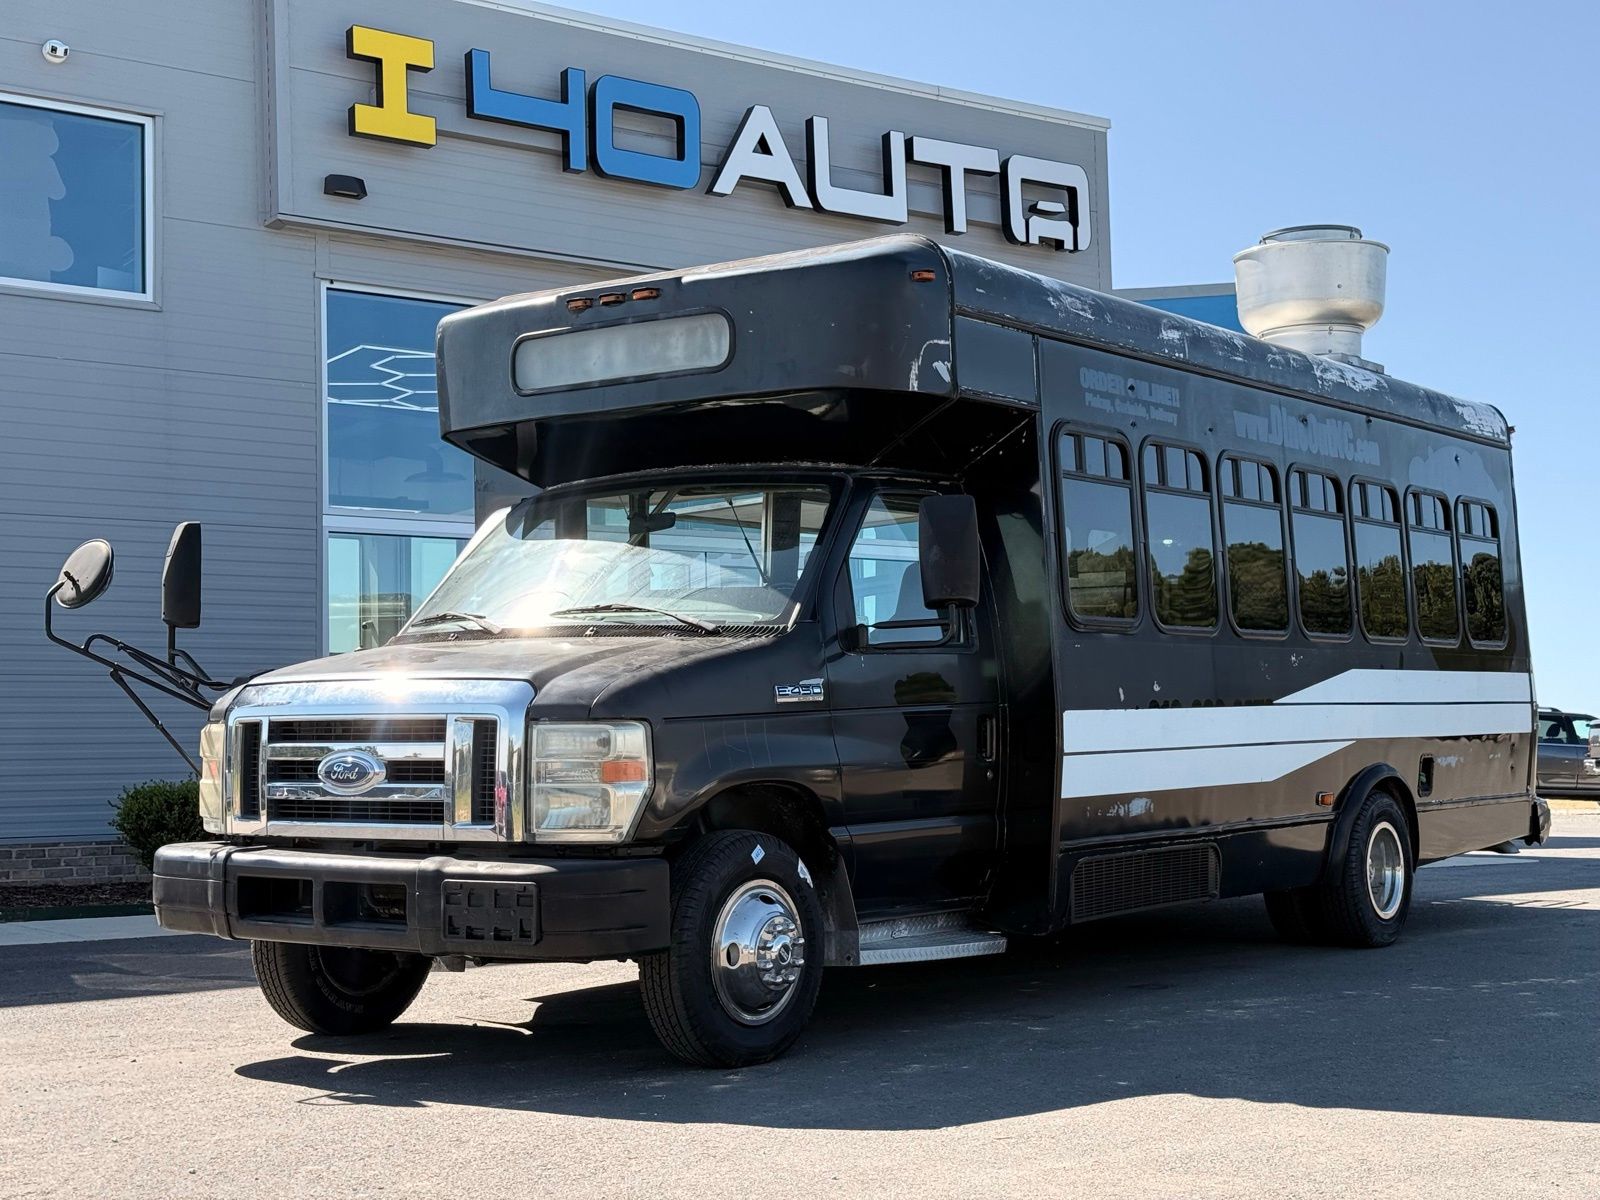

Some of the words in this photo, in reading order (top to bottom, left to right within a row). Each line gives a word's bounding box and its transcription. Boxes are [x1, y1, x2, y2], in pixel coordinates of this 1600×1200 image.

[708, 104, 1091, 253] AUTO
[1079, 366, 1126, 396] ORDER
[330, 762, 359, 780] Ford
